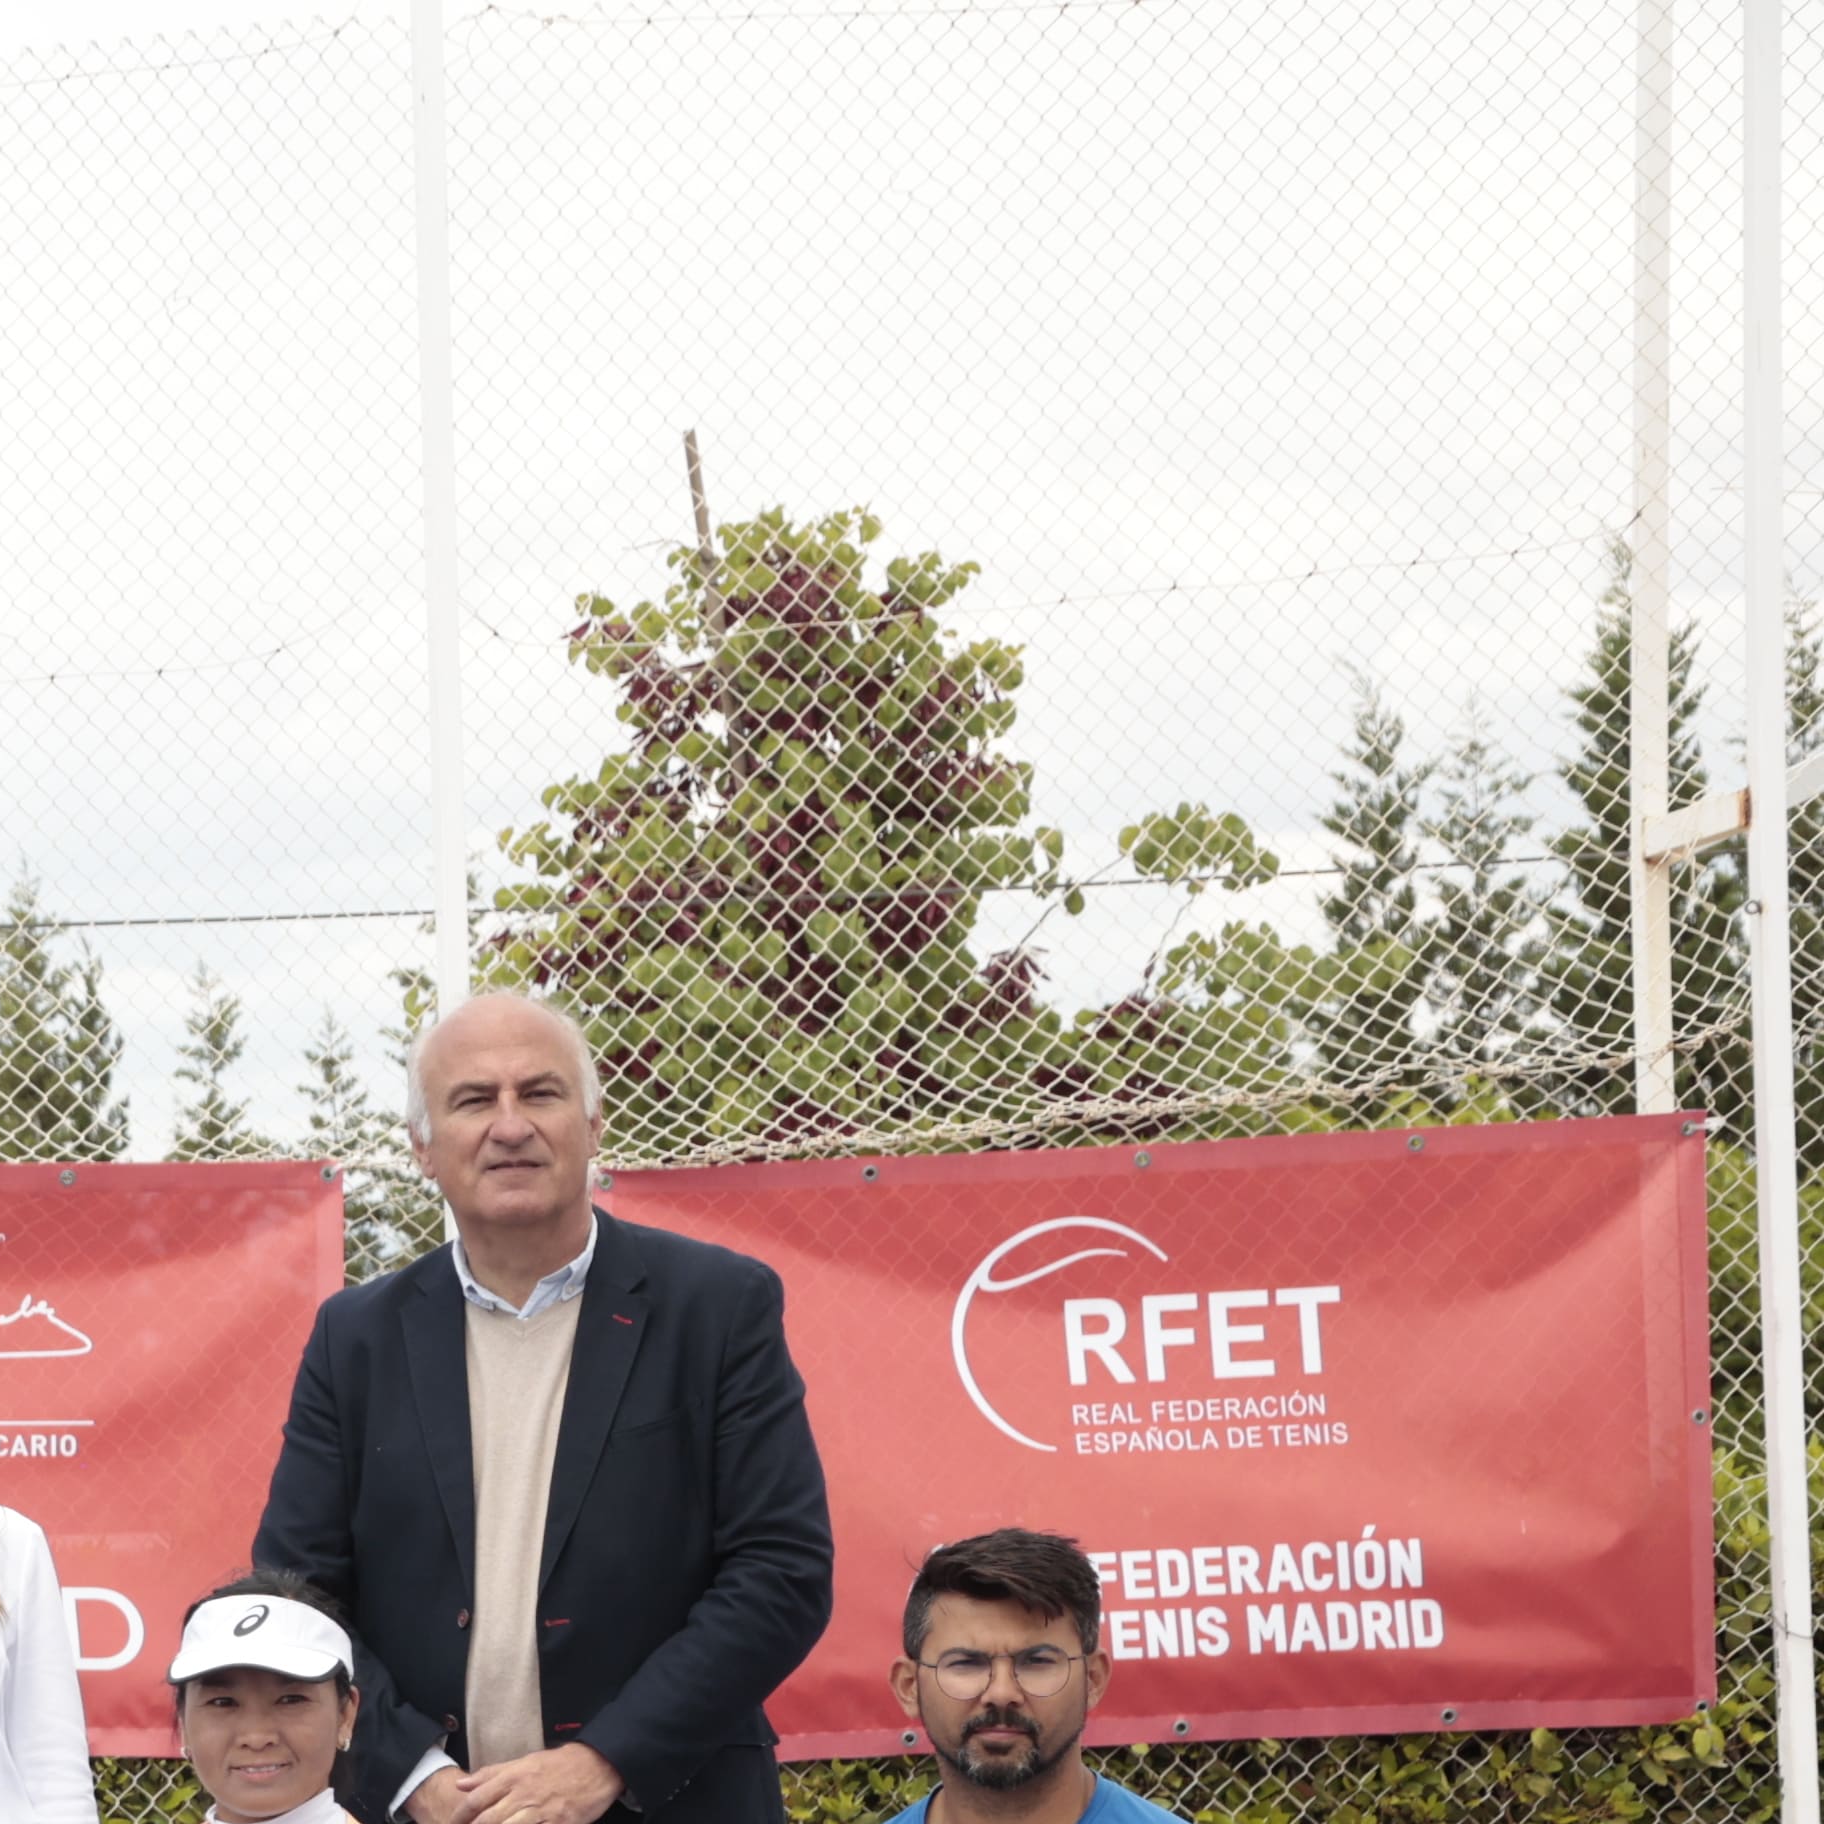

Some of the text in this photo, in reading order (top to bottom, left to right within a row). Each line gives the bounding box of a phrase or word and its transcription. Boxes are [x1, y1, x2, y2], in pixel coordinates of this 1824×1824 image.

[1063, 1285, 1341, 1386] RFET
[1072, 1391, 1326, 1426] REAL FEDERACIÓN
[1075, 1422, 1349, 1455] ESPAÑOLA DE TENIS
[1086, 1525, 1424, 1601] FEDERACIÓN
[1100, 1598, 1445, 1660] ENIS MADRID
